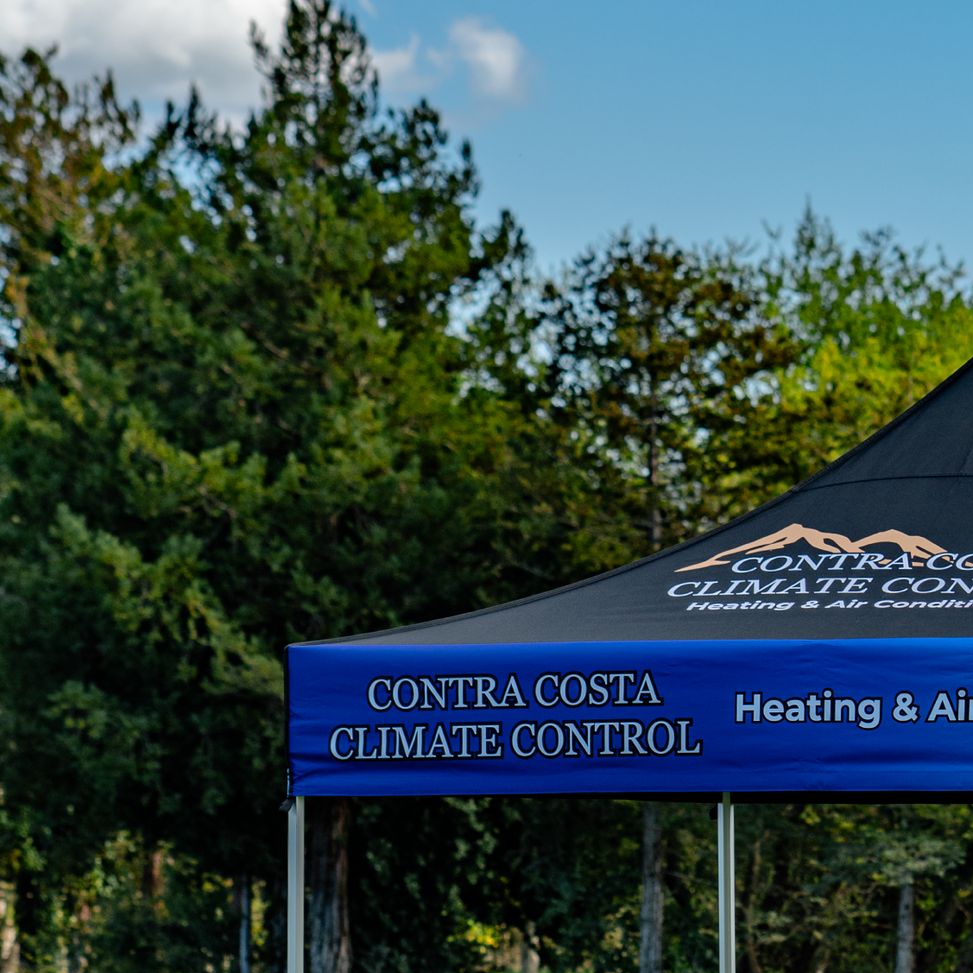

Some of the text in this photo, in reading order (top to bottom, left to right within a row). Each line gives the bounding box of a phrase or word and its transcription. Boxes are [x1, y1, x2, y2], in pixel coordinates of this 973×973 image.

[731, 552, 918, 573] CONTRA
[667, 577, 874, 597] CLIMATE
[686, 600, 793, 612] Heating
[801, 599, 821, 610] &
[825, 599, 870, 609] Air
[367, 671, 662, 711] CONTRA COSTA
[734, 690, 882, 729] Heating
[892, 691, 919, 723] &
[329, 720, 701, 760] CLIMATE CONTROL
